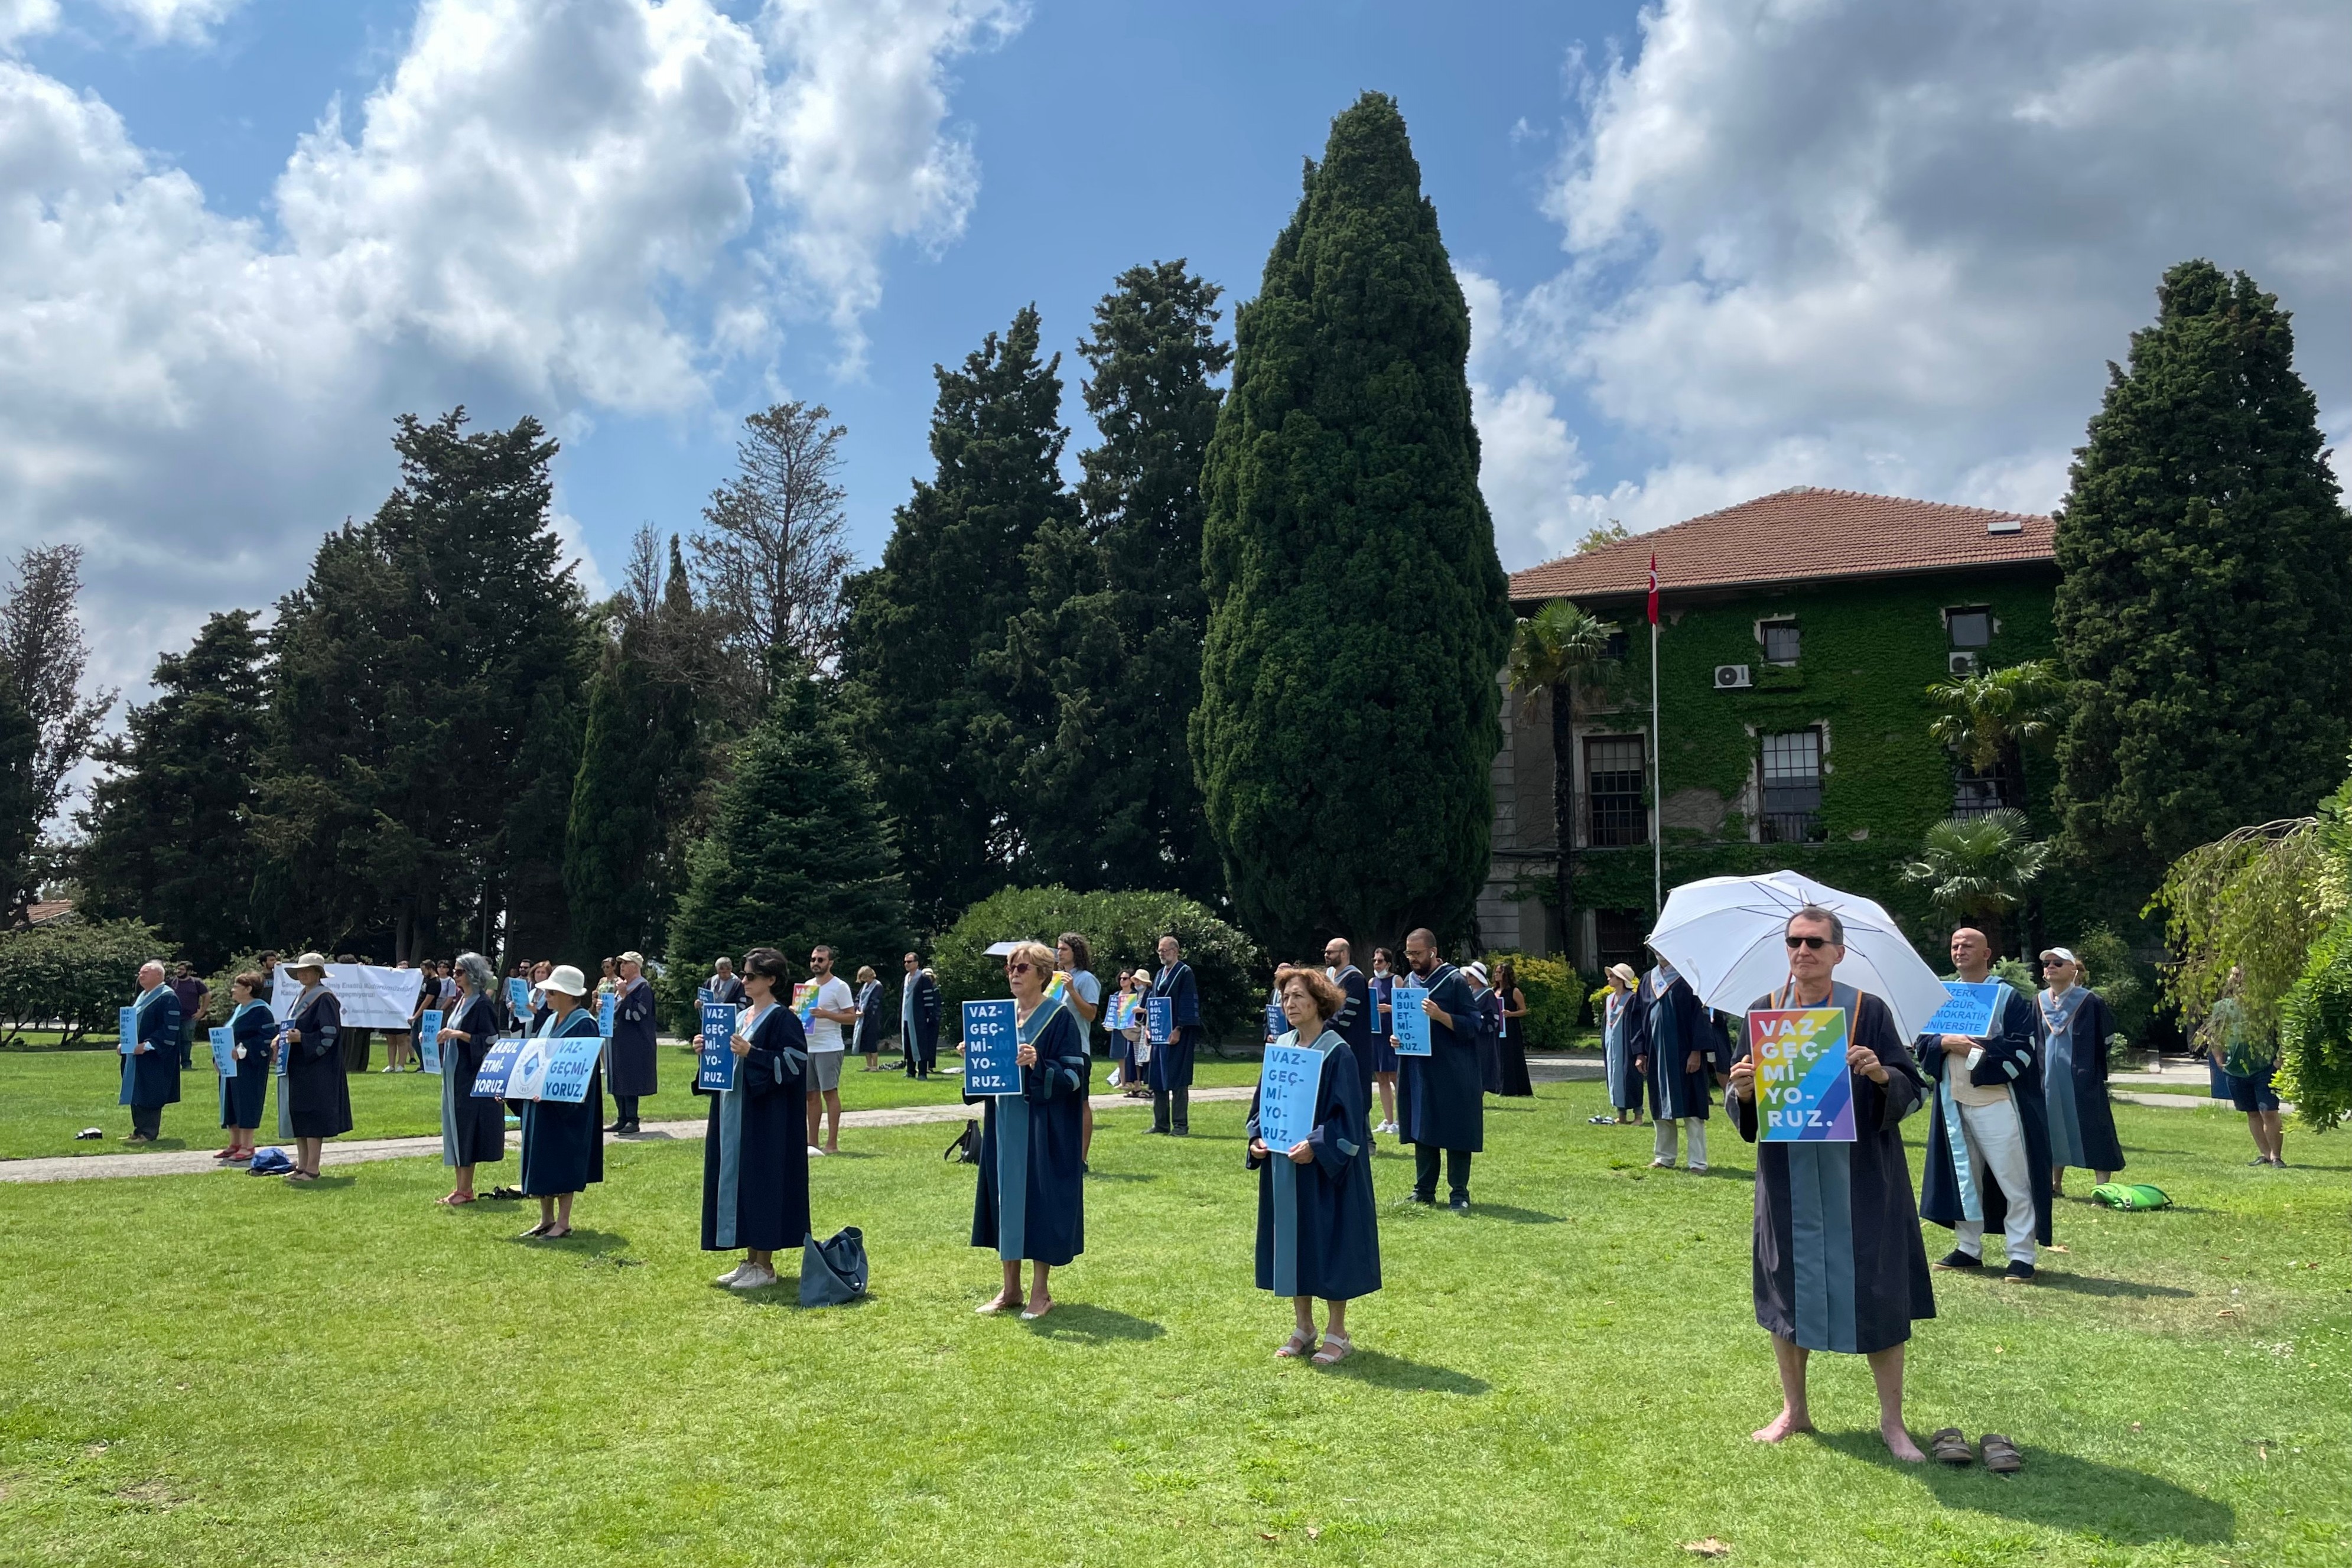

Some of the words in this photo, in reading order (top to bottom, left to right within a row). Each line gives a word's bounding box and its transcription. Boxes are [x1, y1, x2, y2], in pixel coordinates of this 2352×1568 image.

[1941, 999, 1976, 1010] ZGÜR,
[707, 1009, 727, 1019] VAZ-
[970, 1006, 1003, 1017] VAZ-
[1933, 1010, 1988, 1021] MOKRATİK
[705, 1024, 728, 1036] GEÇ-
[970, 1023, 1004, 1036] GEÇ-
[1397, 1020, 1413, 1030] Mİ-
[1759, 1019, 1826, 1036] VAZ-
[489, 1042, 520, 1053] KABUL
[559, 1042, 583, 1053] VAZ-
[705, 1037, 720, 1050] Mİ-
[971, 1037, 992, 1052] Mİ-
[1399, 1043, 1421, 1051] RUZ.
[1272, 1050, 1306, 1065] VAZ-
[1761, 1041, 1830, 1061] GEÇ-
[480, 1056, 505, 1073] ETMİ-
[705, 1055, 721, 1065] YO-
[971, 1058, 996, 1069] YO-
[550, 1058, 588, 1077] GEÇMİ-
[1763, 1059, 1807, 1081] Mİ-
[704, 1072, 725, 1083] RUZ.
[972, 1076, 1006, 1087] RUZ.
[1268, 1069, 1304, 1086] GEÇ-
[474, 1079, 504, 1093] YORUZ.
[546, 1082, 583, 1098] YORUZ.
[1266, 1085, 1287, 1100] Mİ-
[1765, 1087, 1814, 1104] YO-
[1265, 1105, 1287, 1119] YO-
[1768, 1110, 1833, 1127] RUZ.
[1264, 1127, 1292, 1143] RUZ.
